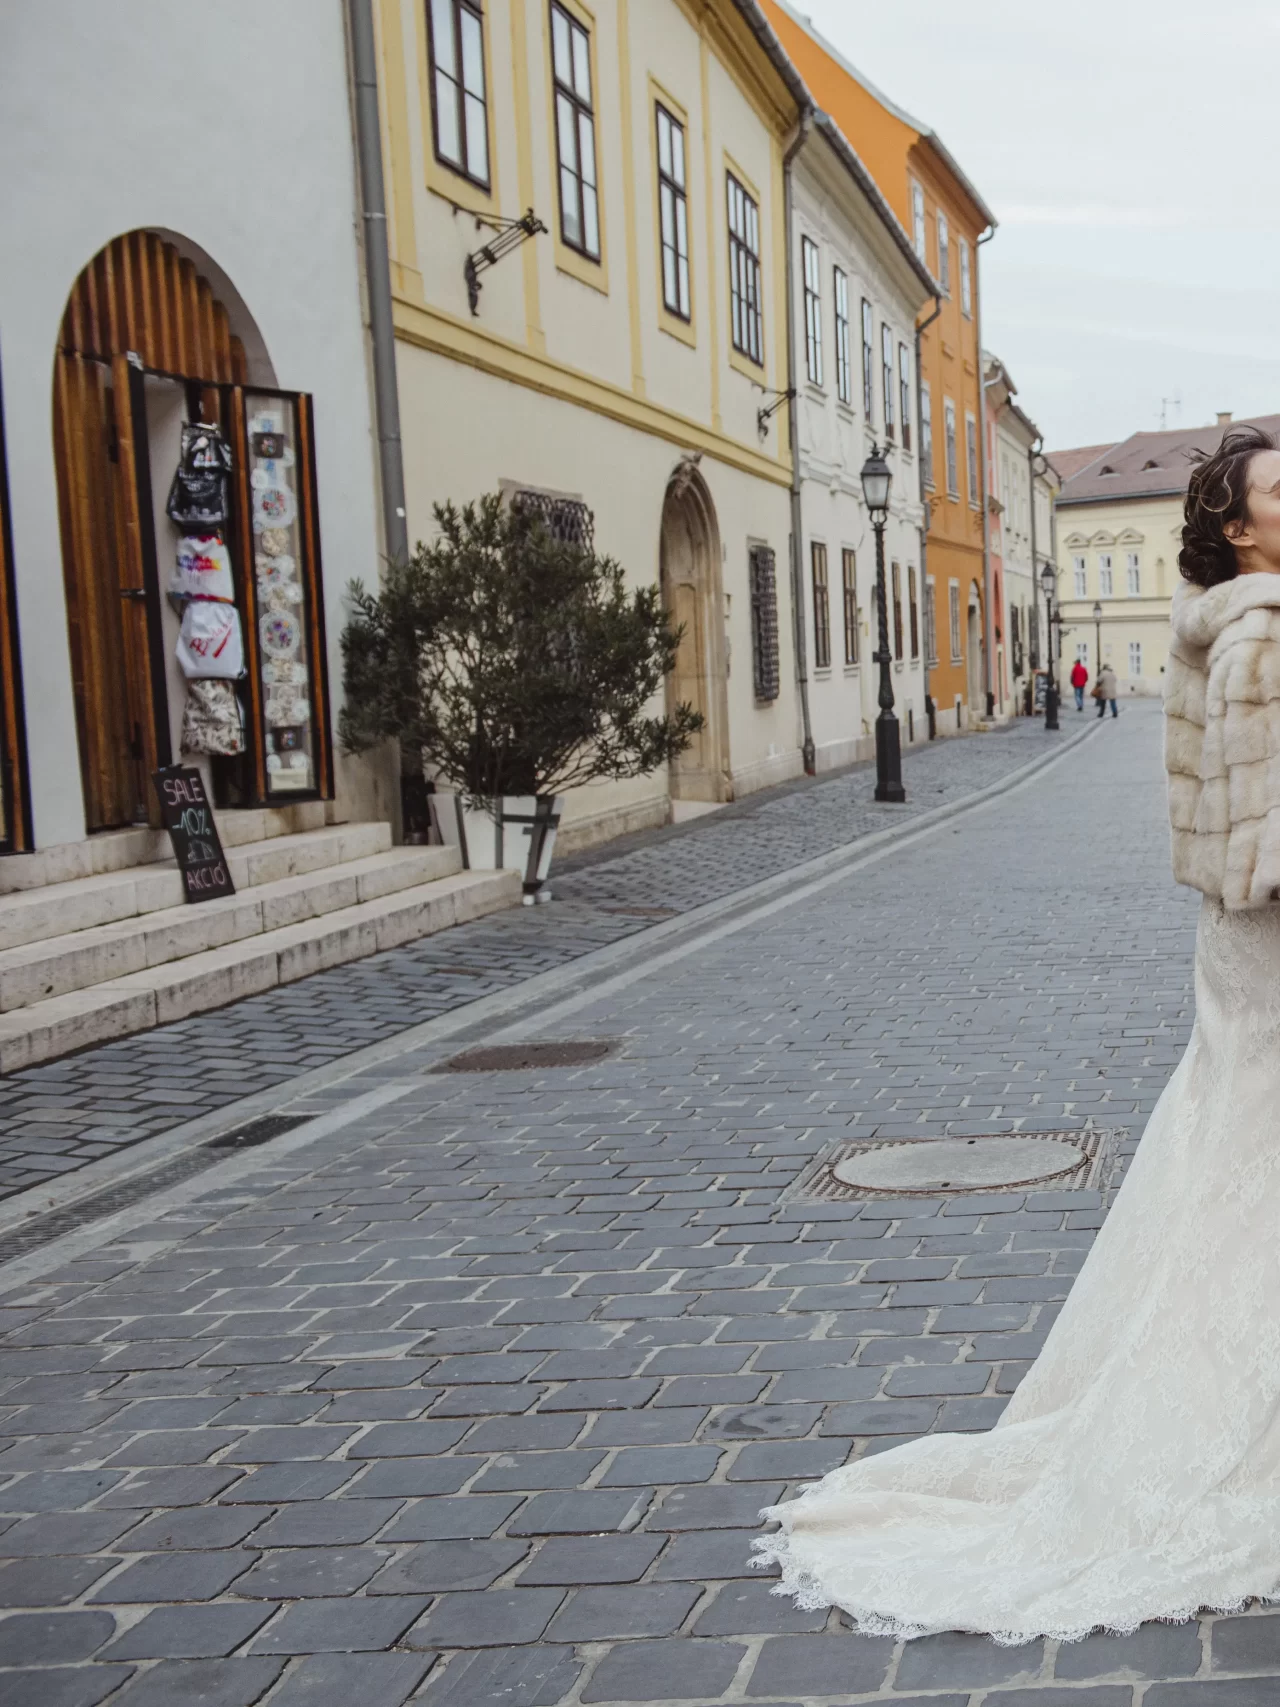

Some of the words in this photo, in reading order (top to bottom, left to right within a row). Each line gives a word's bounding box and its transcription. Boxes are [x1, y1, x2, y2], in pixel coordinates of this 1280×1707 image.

[163, 778, 204, 806] SALE
[172, 807, 212, 836] -10%
[186, 861, 226, 891] AKCIÓ
